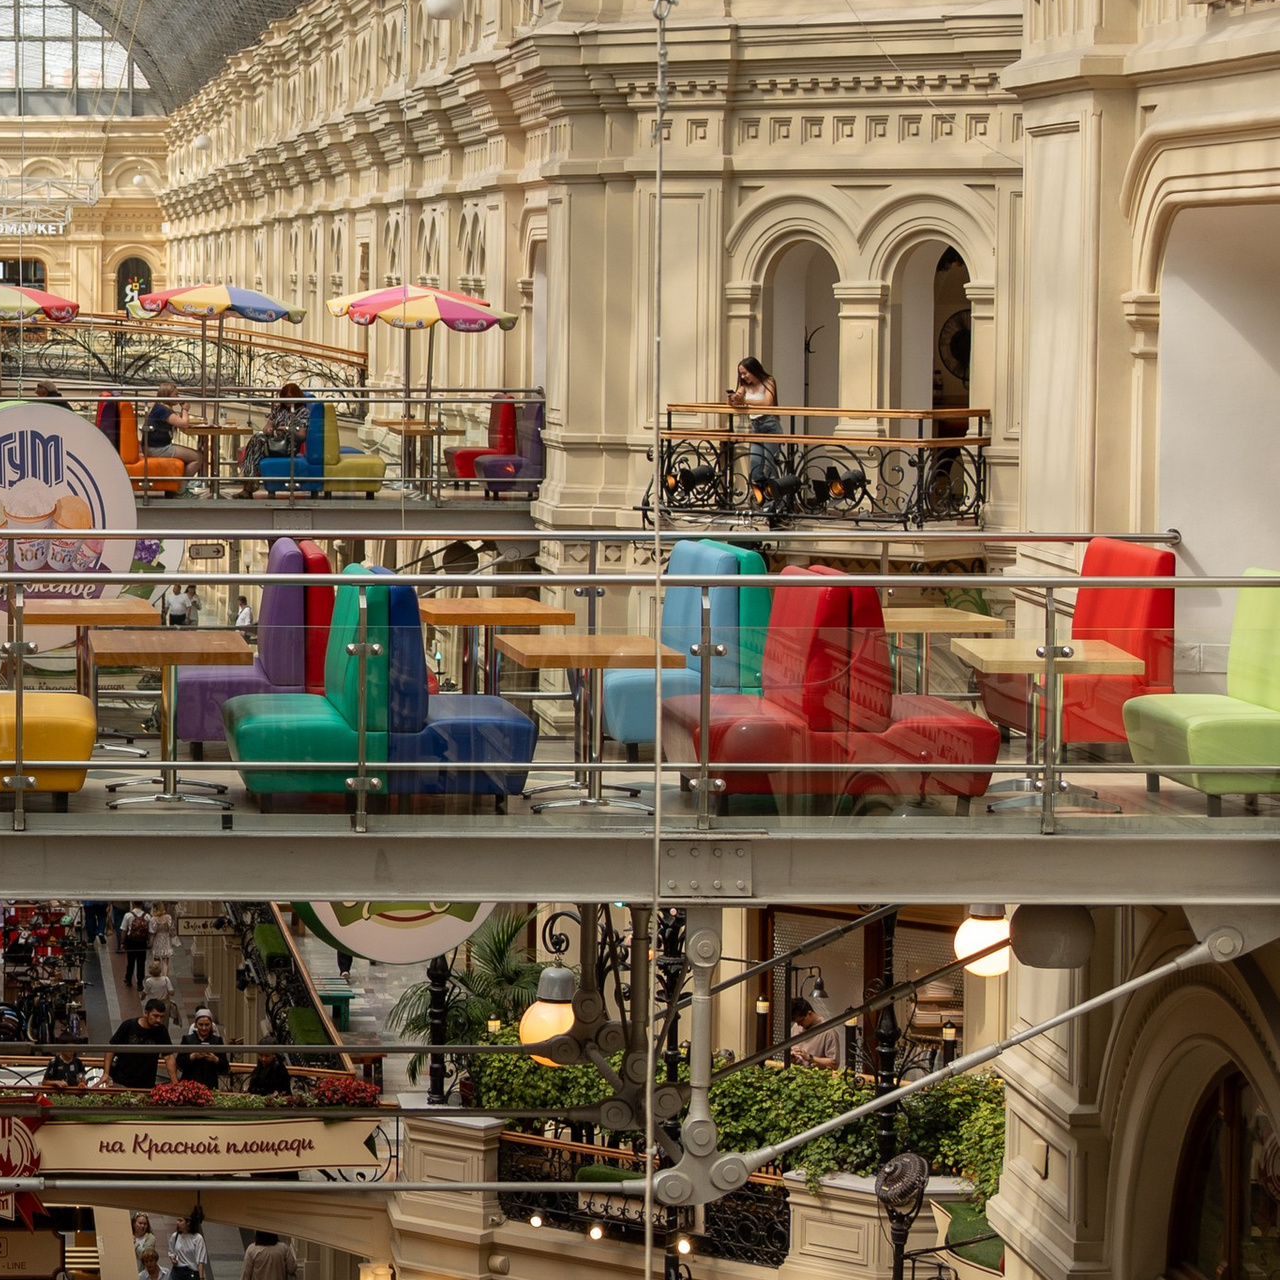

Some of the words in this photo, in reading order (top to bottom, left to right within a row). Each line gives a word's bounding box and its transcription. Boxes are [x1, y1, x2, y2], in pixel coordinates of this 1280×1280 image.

[99, 1140, 125, 1154] на
[132, 1133, 220, 1160] Красной
[226, 1136, 315, 1158] площади
[7, 1262, 26, 1270] LINE
